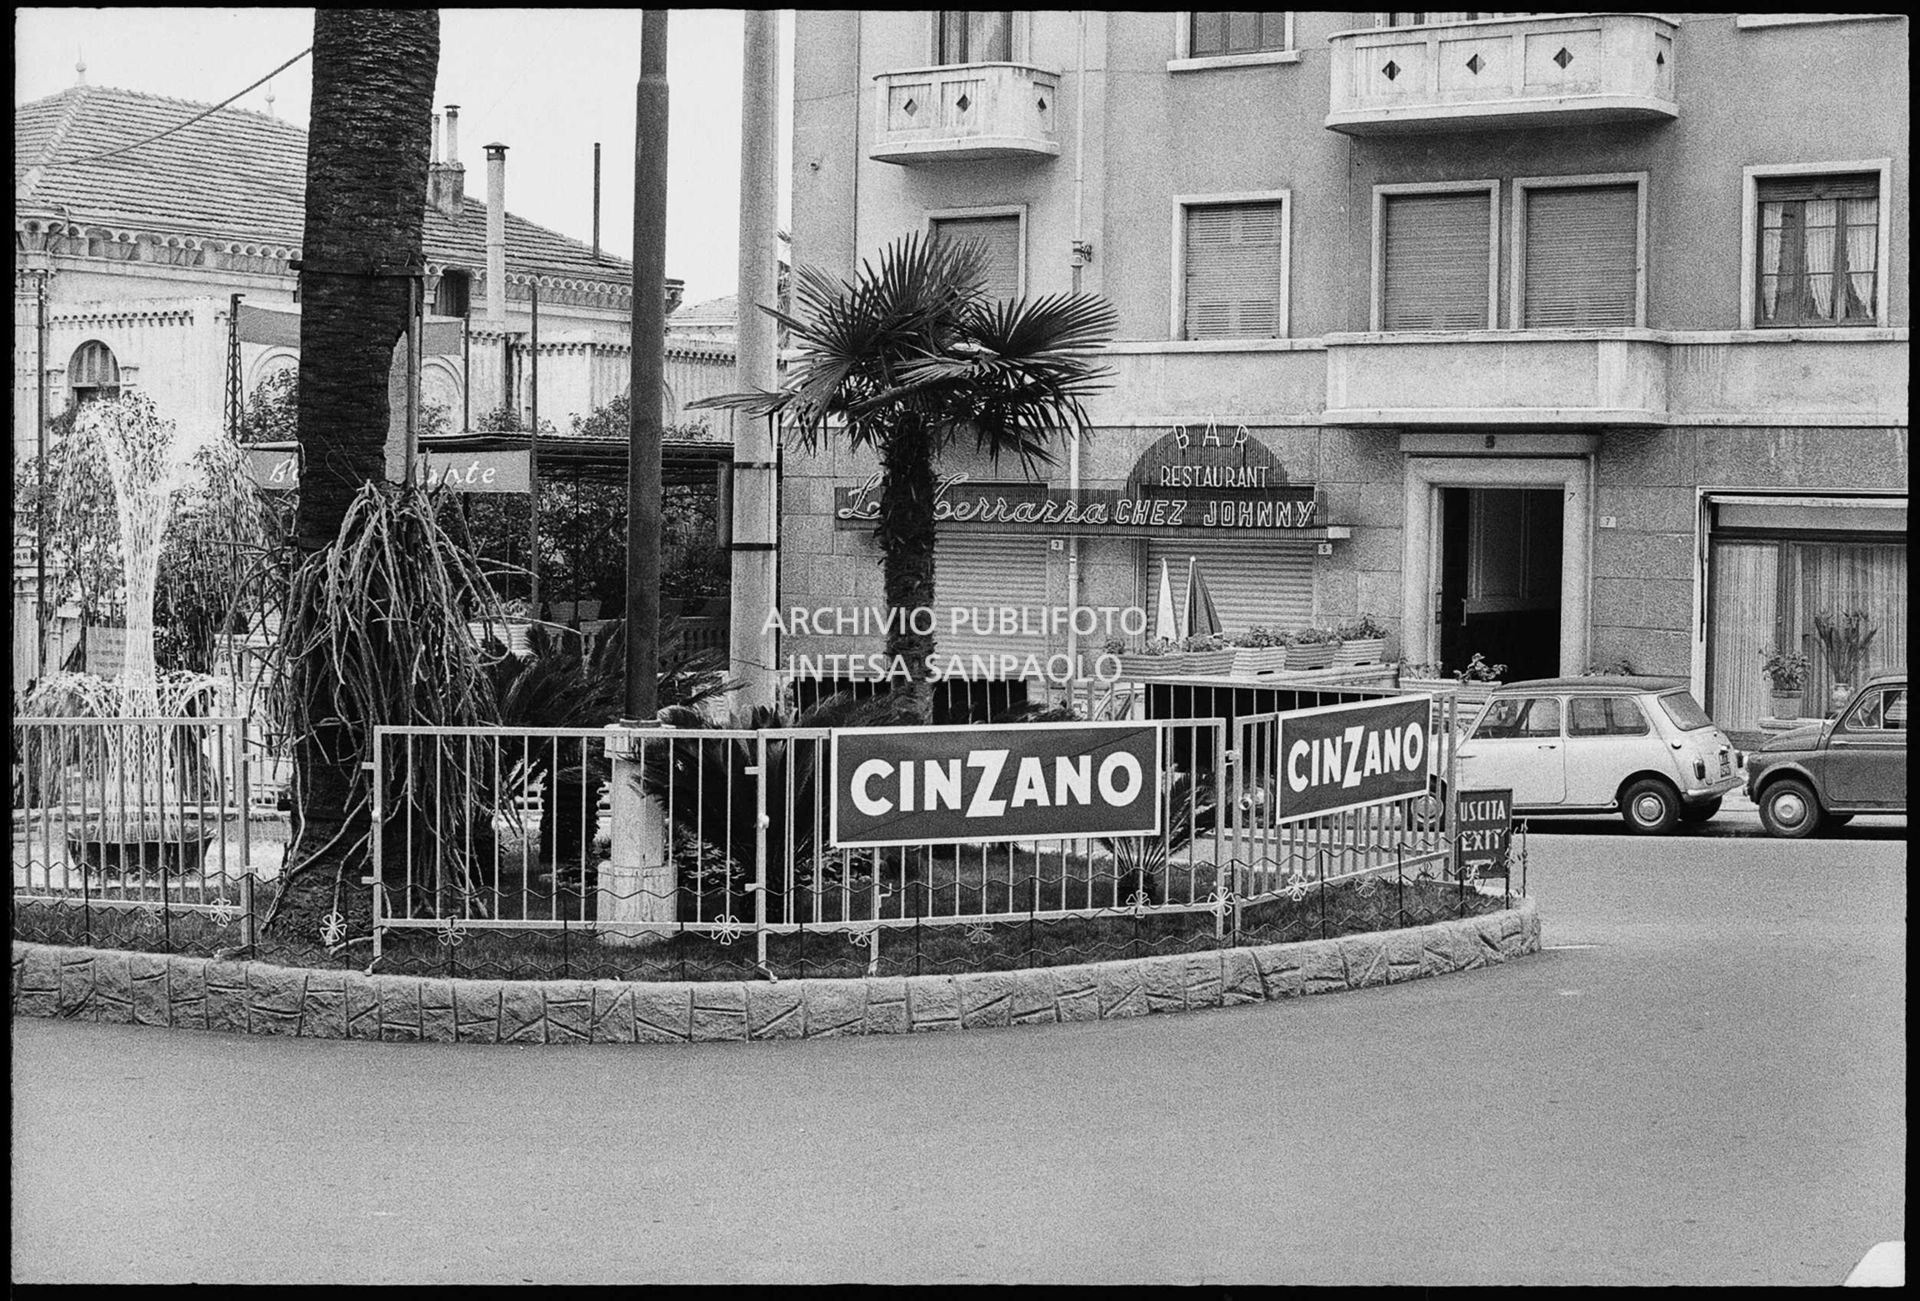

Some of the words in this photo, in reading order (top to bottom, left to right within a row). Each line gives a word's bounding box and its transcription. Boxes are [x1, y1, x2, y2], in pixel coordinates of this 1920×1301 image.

[1160, 465, 1269, 488] RESTAURANT
[1115, 499, 1188, 525] CHEZ
[1203, 501, 1318, 527] JOHNNY
[1286, 724, 1424, 792] CINZANO
[850, 749, 1143, 818] CINZANO
[1460, 800, 1506, 821] USCITA
[1461, 829, 1502, 851] EXIT
